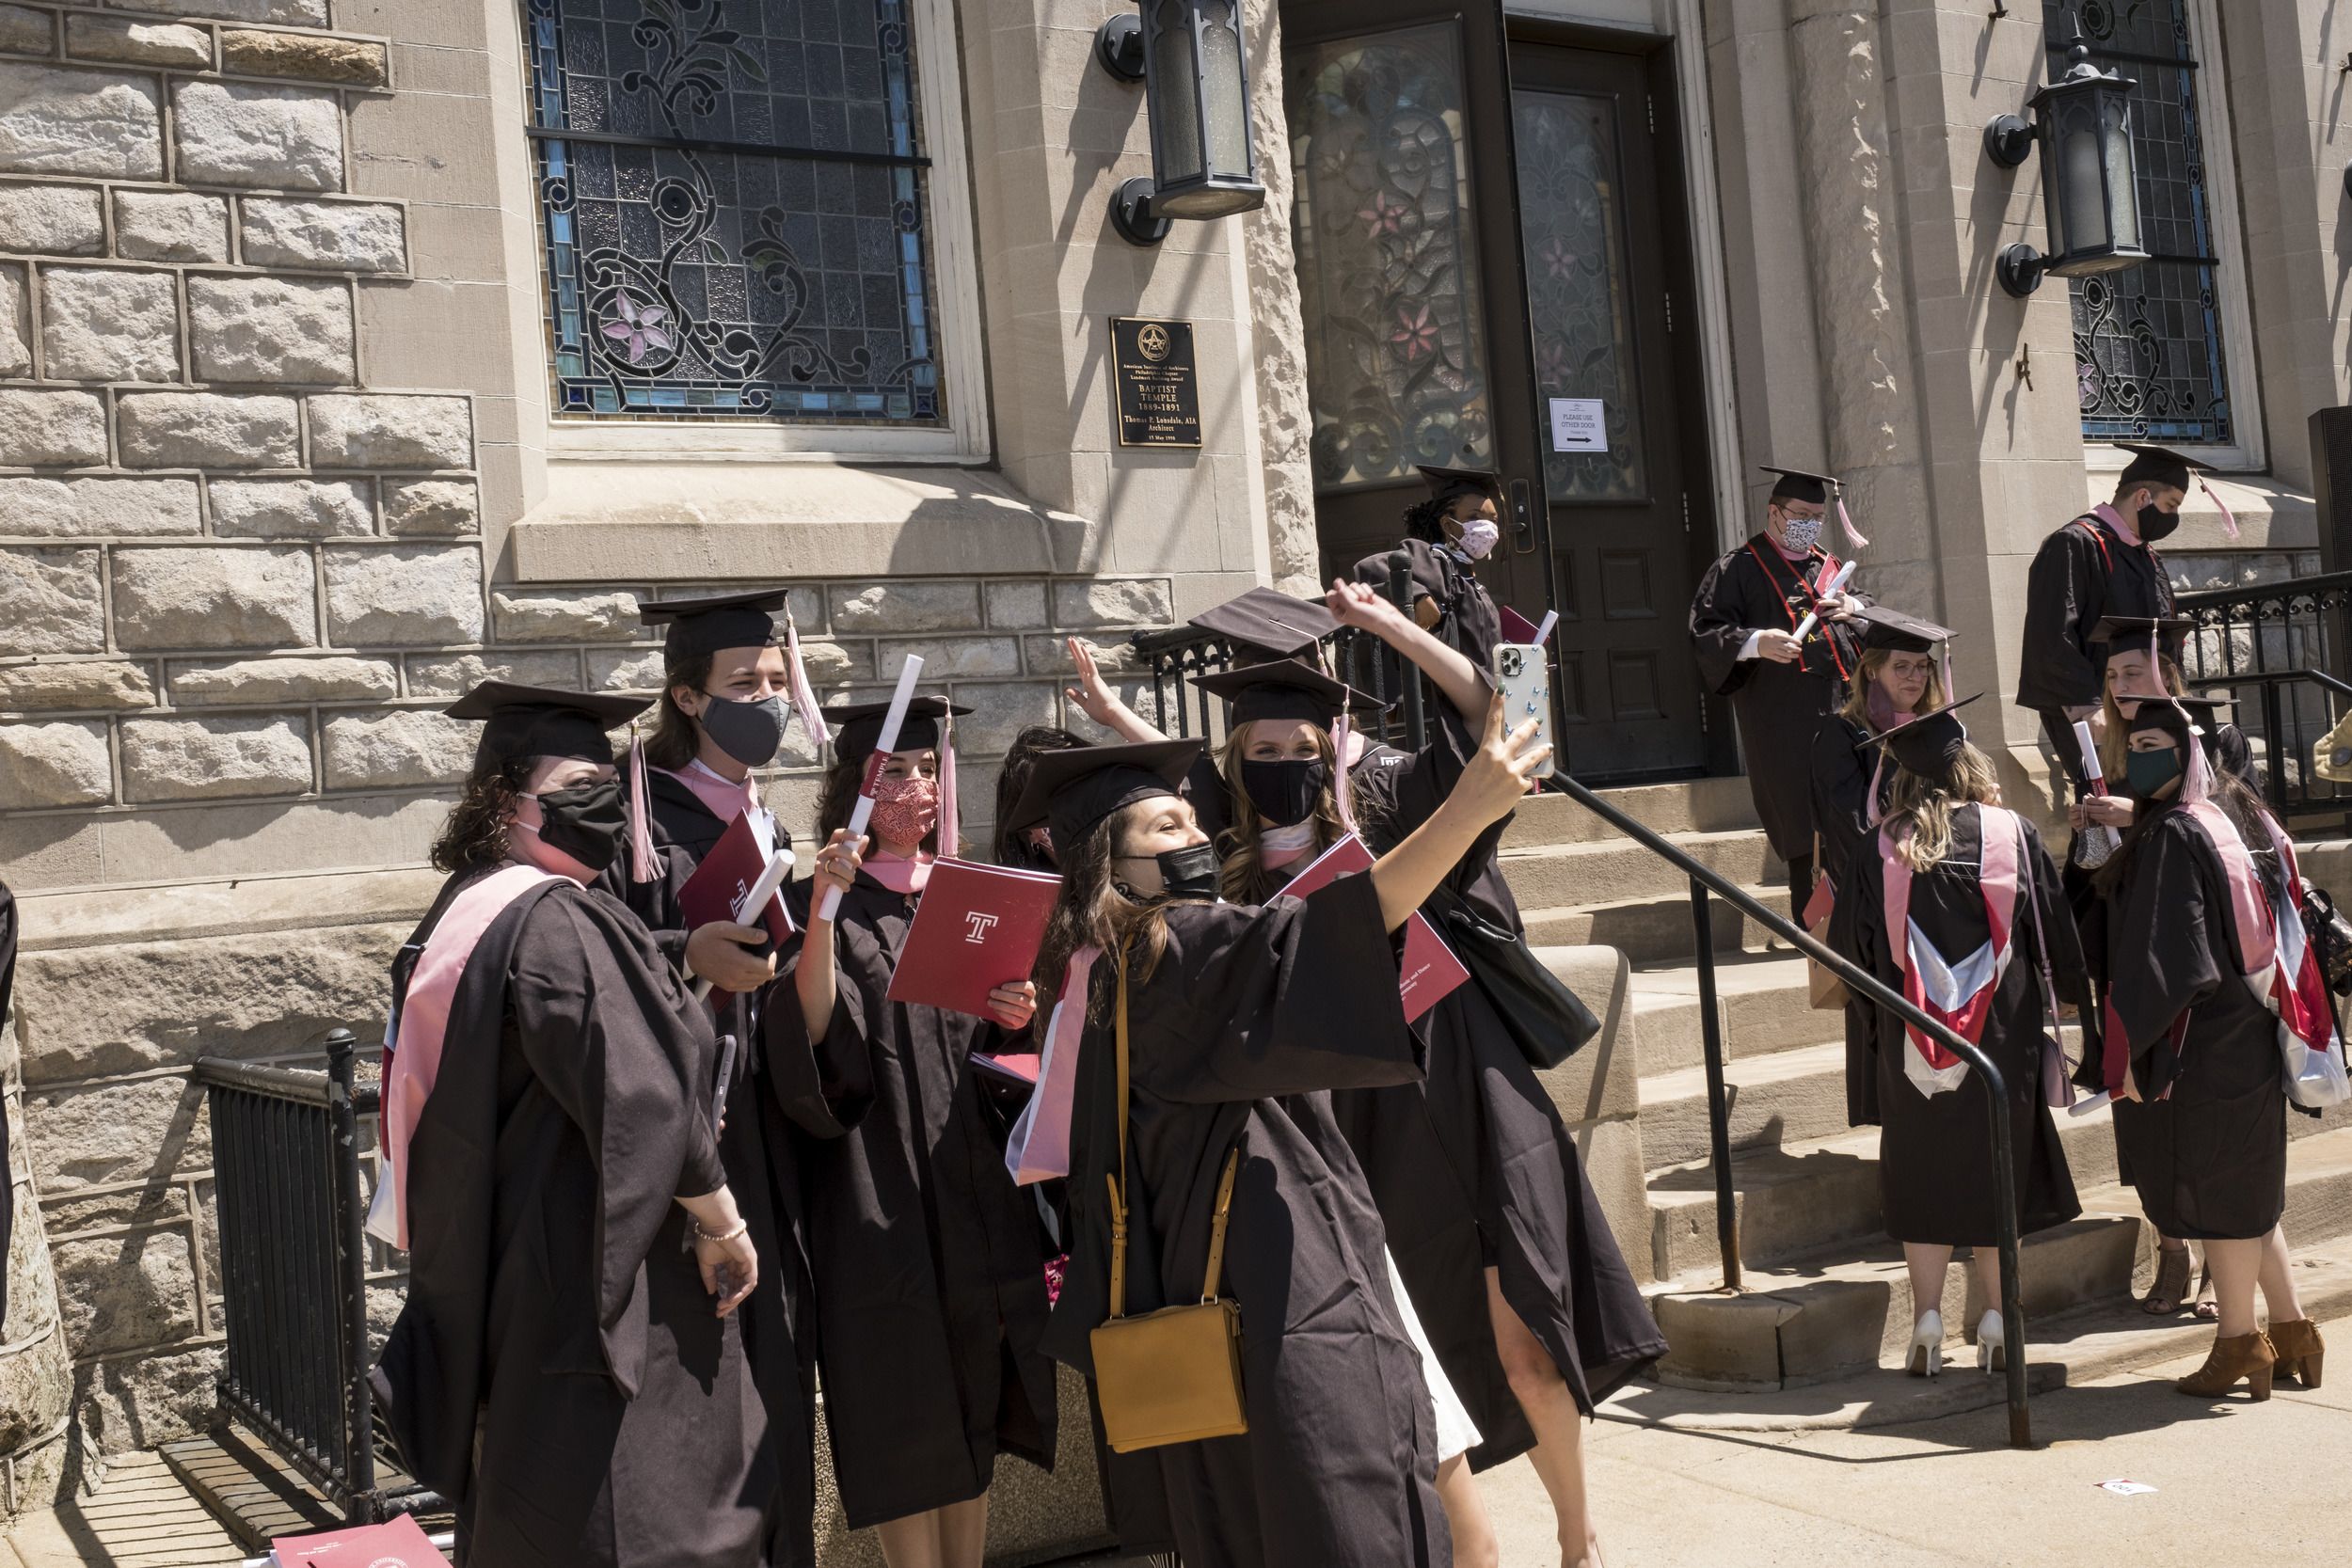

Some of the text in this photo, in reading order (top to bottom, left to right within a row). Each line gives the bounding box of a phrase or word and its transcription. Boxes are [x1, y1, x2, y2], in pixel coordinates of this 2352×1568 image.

[1138, 385, 1177, 393] BAPTIST
[1140, 393, 1177, 403] TEMPLE
[1138, 403, 1180, 412] 1889-1891
[1124, 415, 1147, 423] Thomas
[872, 755, 890, 787] TEMPLE
[964, 911, 999, 944] T
[1417, 963, 1431, 974] Dance
